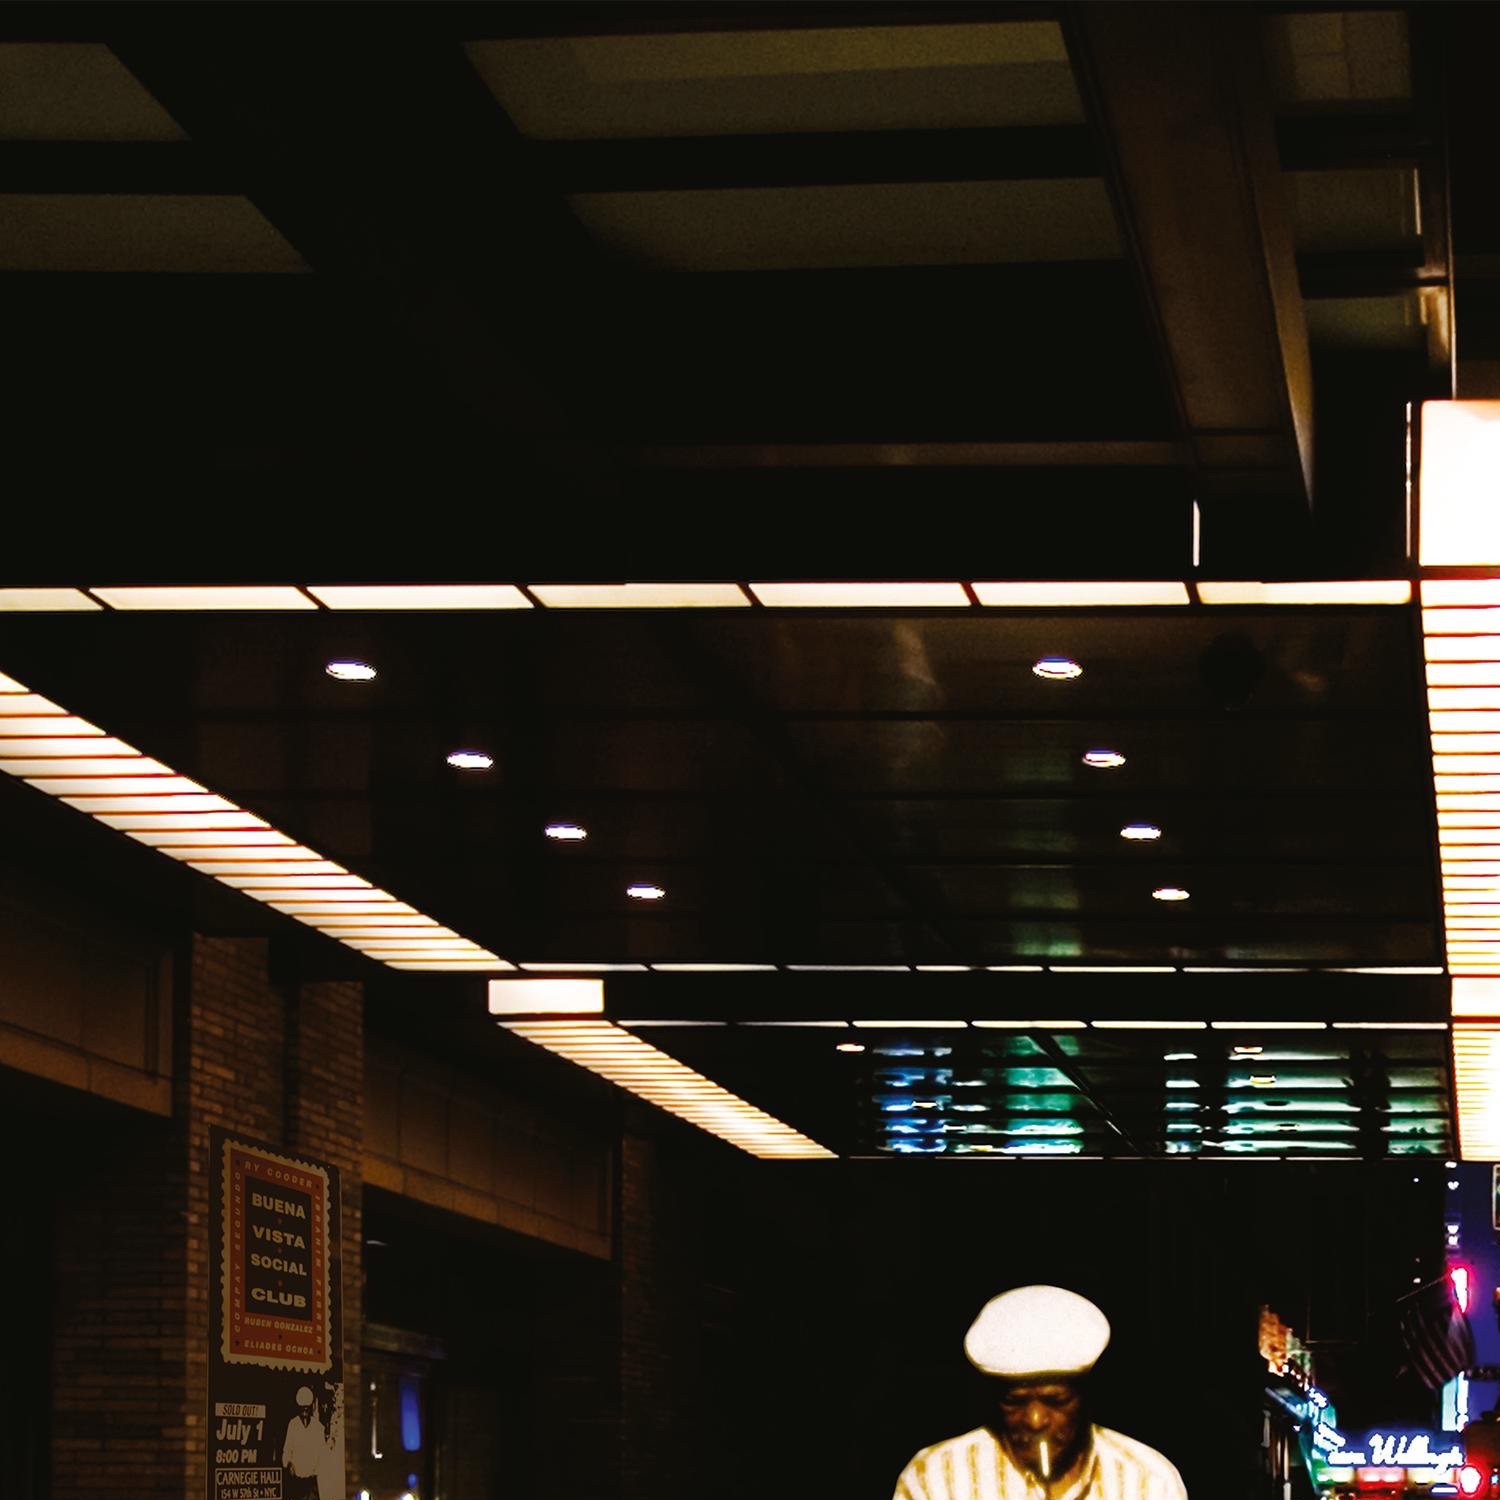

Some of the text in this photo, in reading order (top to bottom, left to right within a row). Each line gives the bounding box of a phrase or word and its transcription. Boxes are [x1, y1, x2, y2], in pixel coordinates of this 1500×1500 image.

[244, 1160, 313, 1189] RY COODER
[251, 1191, 306, 1220] BUENA
[251, 1224, 306, 1249] VISTA
[250, 1252, 308, 1277] SOCIAL
[250, 1287, 307, 1308] CLUB
[222, 1404, 240, 1416] SOLD
[215, 1418, 264, 1446] July 1
[215, 1448, 257, 1464] 8:00 PM
[216, 1470, 281, 1486] CARNEGIE HALL
[232, 1488, 238, 1498] W
[264, 1487, 277, 1498] NYC
